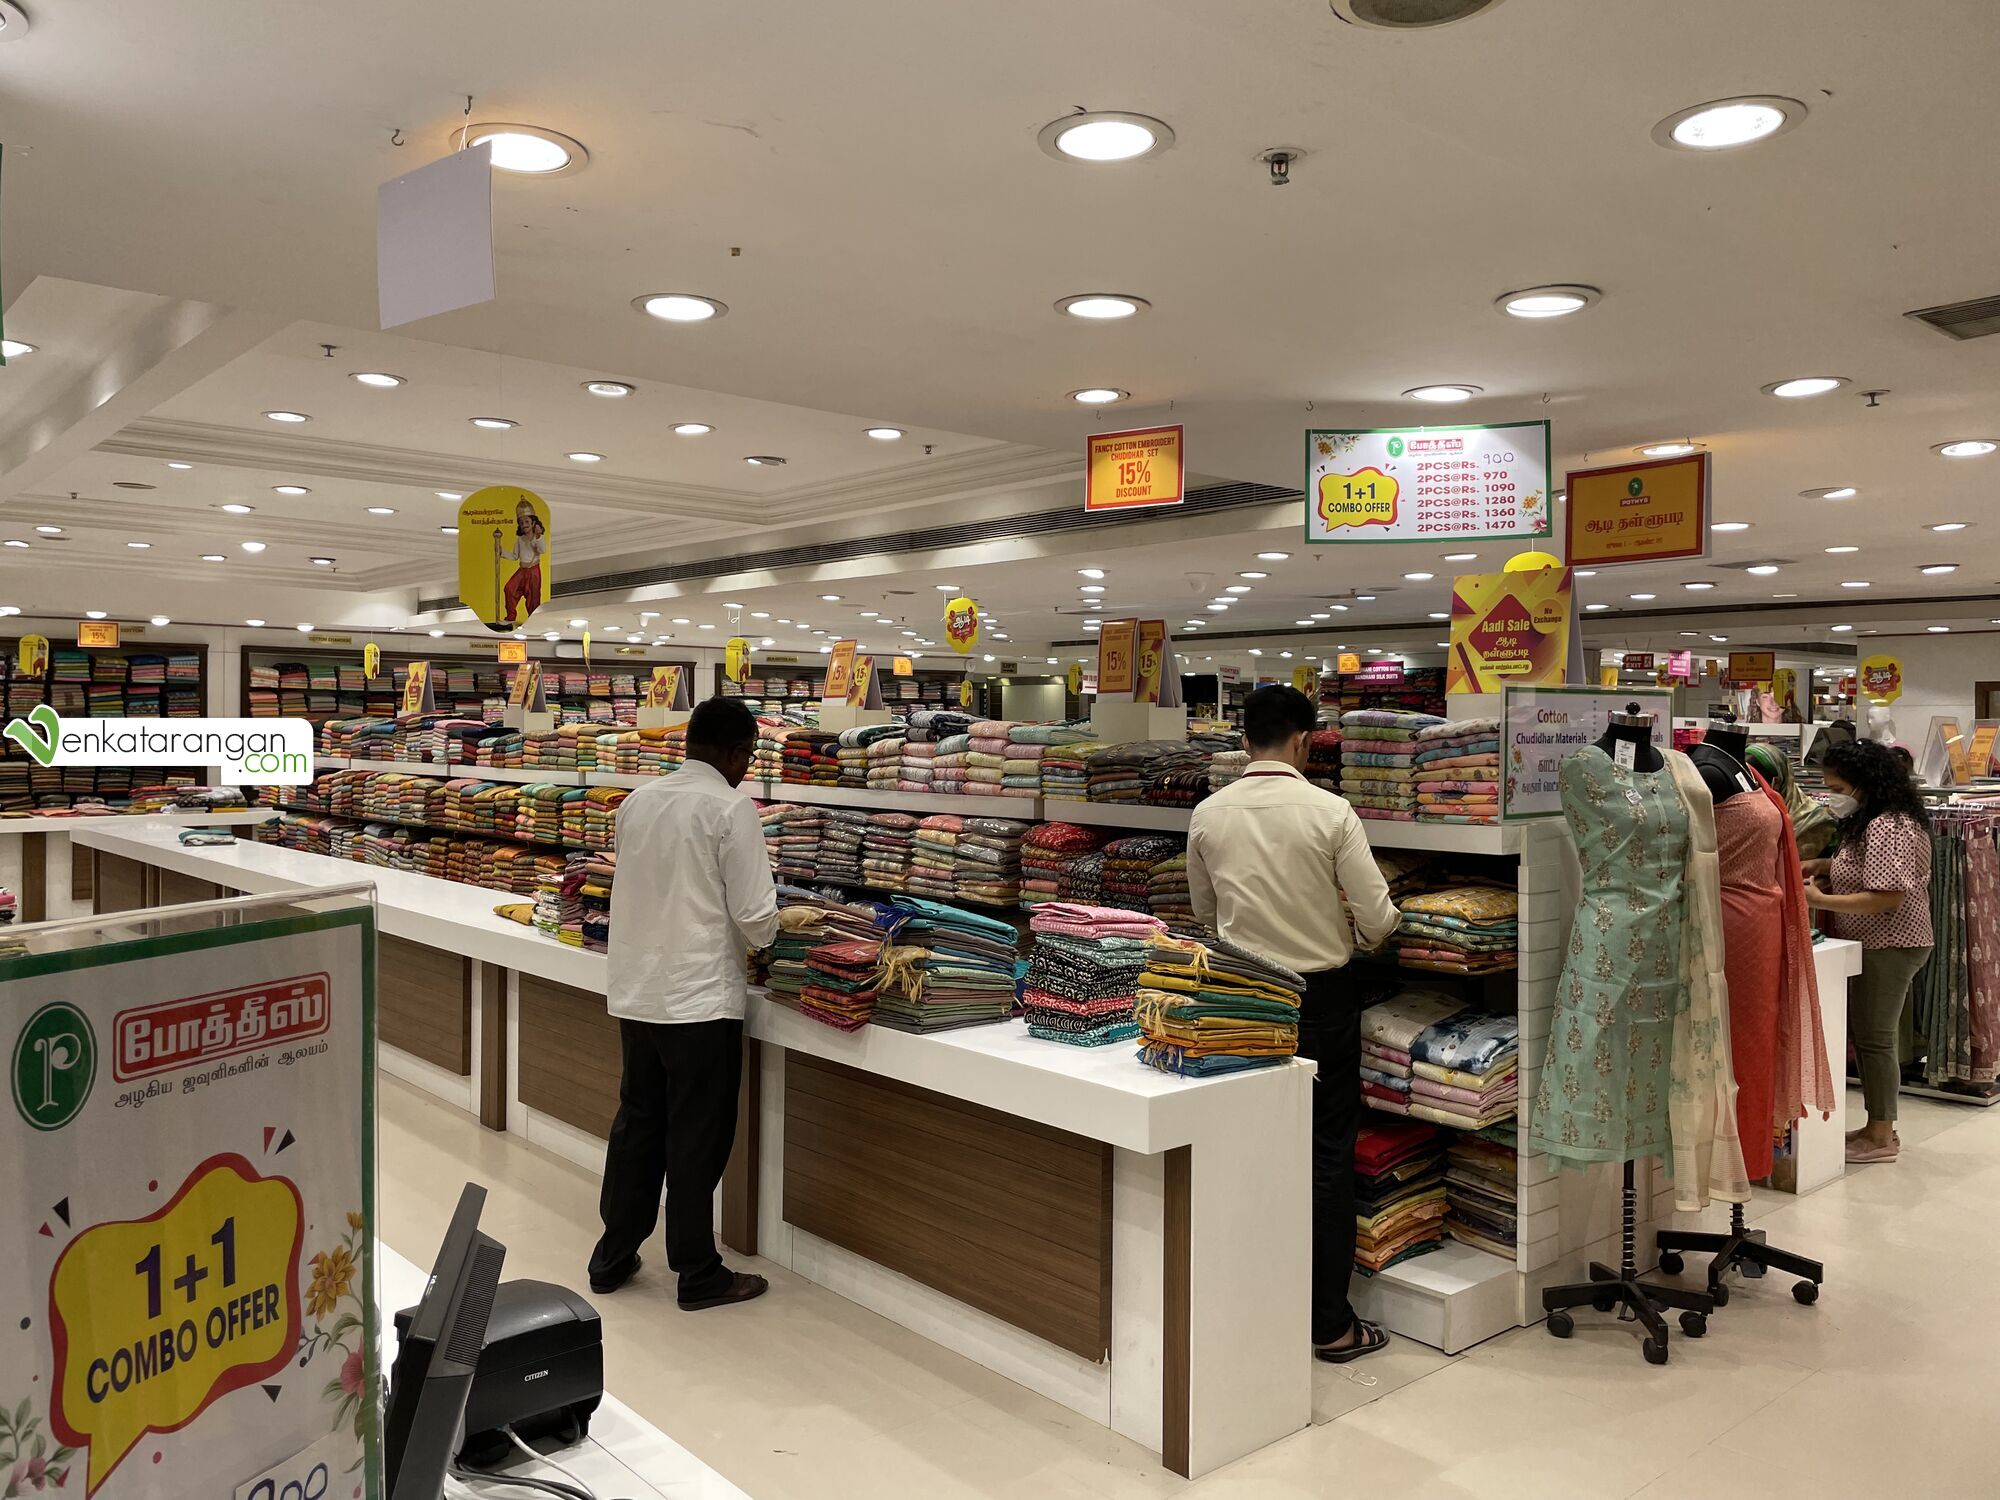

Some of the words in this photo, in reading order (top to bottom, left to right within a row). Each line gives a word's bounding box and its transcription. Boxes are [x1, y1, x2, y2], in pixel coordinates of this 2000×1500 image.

[1095, 443, 1113, 453] FANCY
[1114, 441, 1137, 451] COTTON
[1138, 437, 1175, 449] EMBROIDERY
[1111, 450, 1144, 461] CHUDIDHAR
[1147, 448, 1158, 457] SET
[1484, 452, 1514, 464] 900
[1119, 460, 1151, 485] 15%
[1417, 461, 1480, 471] 2PCS@Rs.
[1417, 472, 1480, 483] 2PCS@Rs.
[1484, 471, 1508, 480] 970
[1116, 485, 1152, 498] DISCOUNT
[1343, 482, 1376, 499] 1+1
[1417, 483, 1480, 495] 2PCS@Rs.
[1484, 483, 1515, 492] 1090
[1328, 502, 1362, 513] COMBO
[1364, 502, 1391, 513] OFFER
[1417, 496, 1480, 507] 2PCS@Rs.
[1484, 495, 1515, 505] 1280
[1417, 508, 1480, 520] 2PCS@Rs.
[1484, 508, 1515, 517] 1360
[1417, 521, 1480, 532] 2PCS@Rs.
[1484, 520, 1516, 530] 1470
[1481, 619, 1504, 633] Aadi
[1507, 619, 1530, 631] Sale
[1533, 616, 1562, 624] Exchange
[1496, 636, 1518, 647] ஆடி
[1106, 651, 1127, 671] 15%
[1537, 708, 1568, 724] Cotton
[1516, 732, 1555, 745] Chudidhar
[1555, 732, 1587, 744] Materials
[124, 987, 323, 1065] போத்தீஸ்
[114, 1080, 173, 1109] அழகிய
[182, 1053, 270, 1094] ஜவுளிகளின்
[277, 1039, 329, 1067] ஆலயம்
[135, 1216, 236, 1320] 1+1
[87, 1318, 198, 1404] COMBO
[205, 1283, 280, 1349] OFFER
[524, 1369, 549, 1382] CITIZEN
